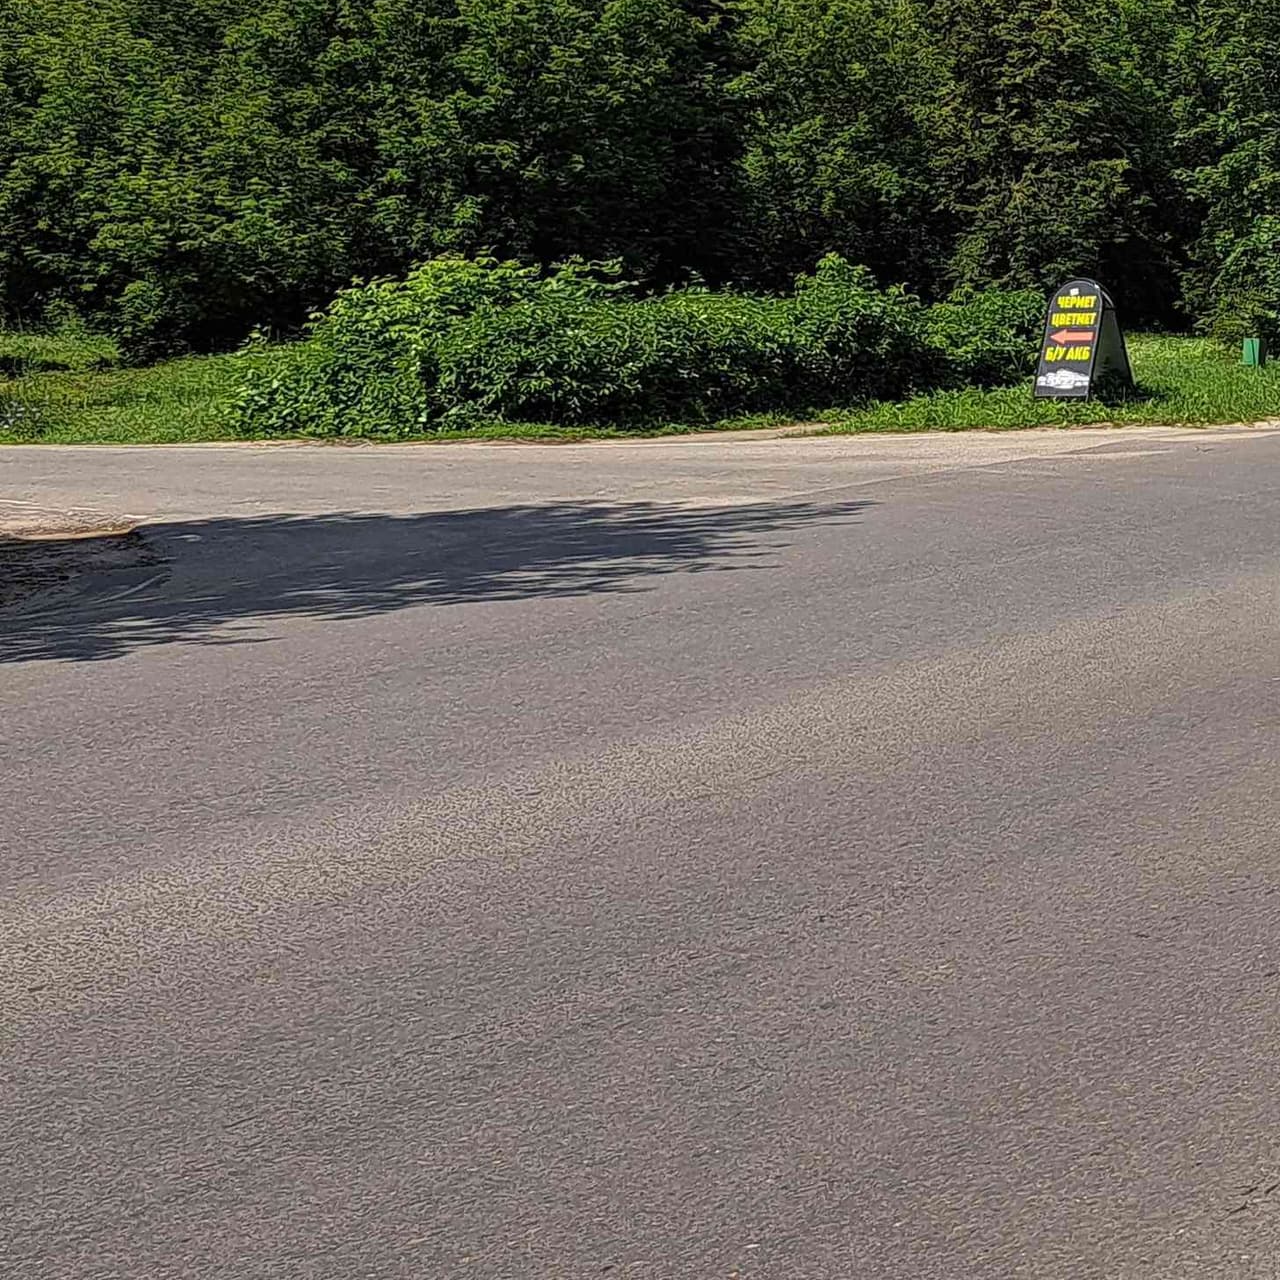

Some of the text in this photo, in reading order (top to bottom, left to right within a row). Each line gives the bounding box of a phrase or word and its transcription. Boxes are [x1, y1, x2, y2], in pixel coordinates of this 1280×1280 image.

[1057, 295, 1097, 308] ЧЕРМЕТ
[1051, 313, 1096, 327] ЦВЕТМЕТ
[1045, 345, 1091, 361] Б/У АКБ
